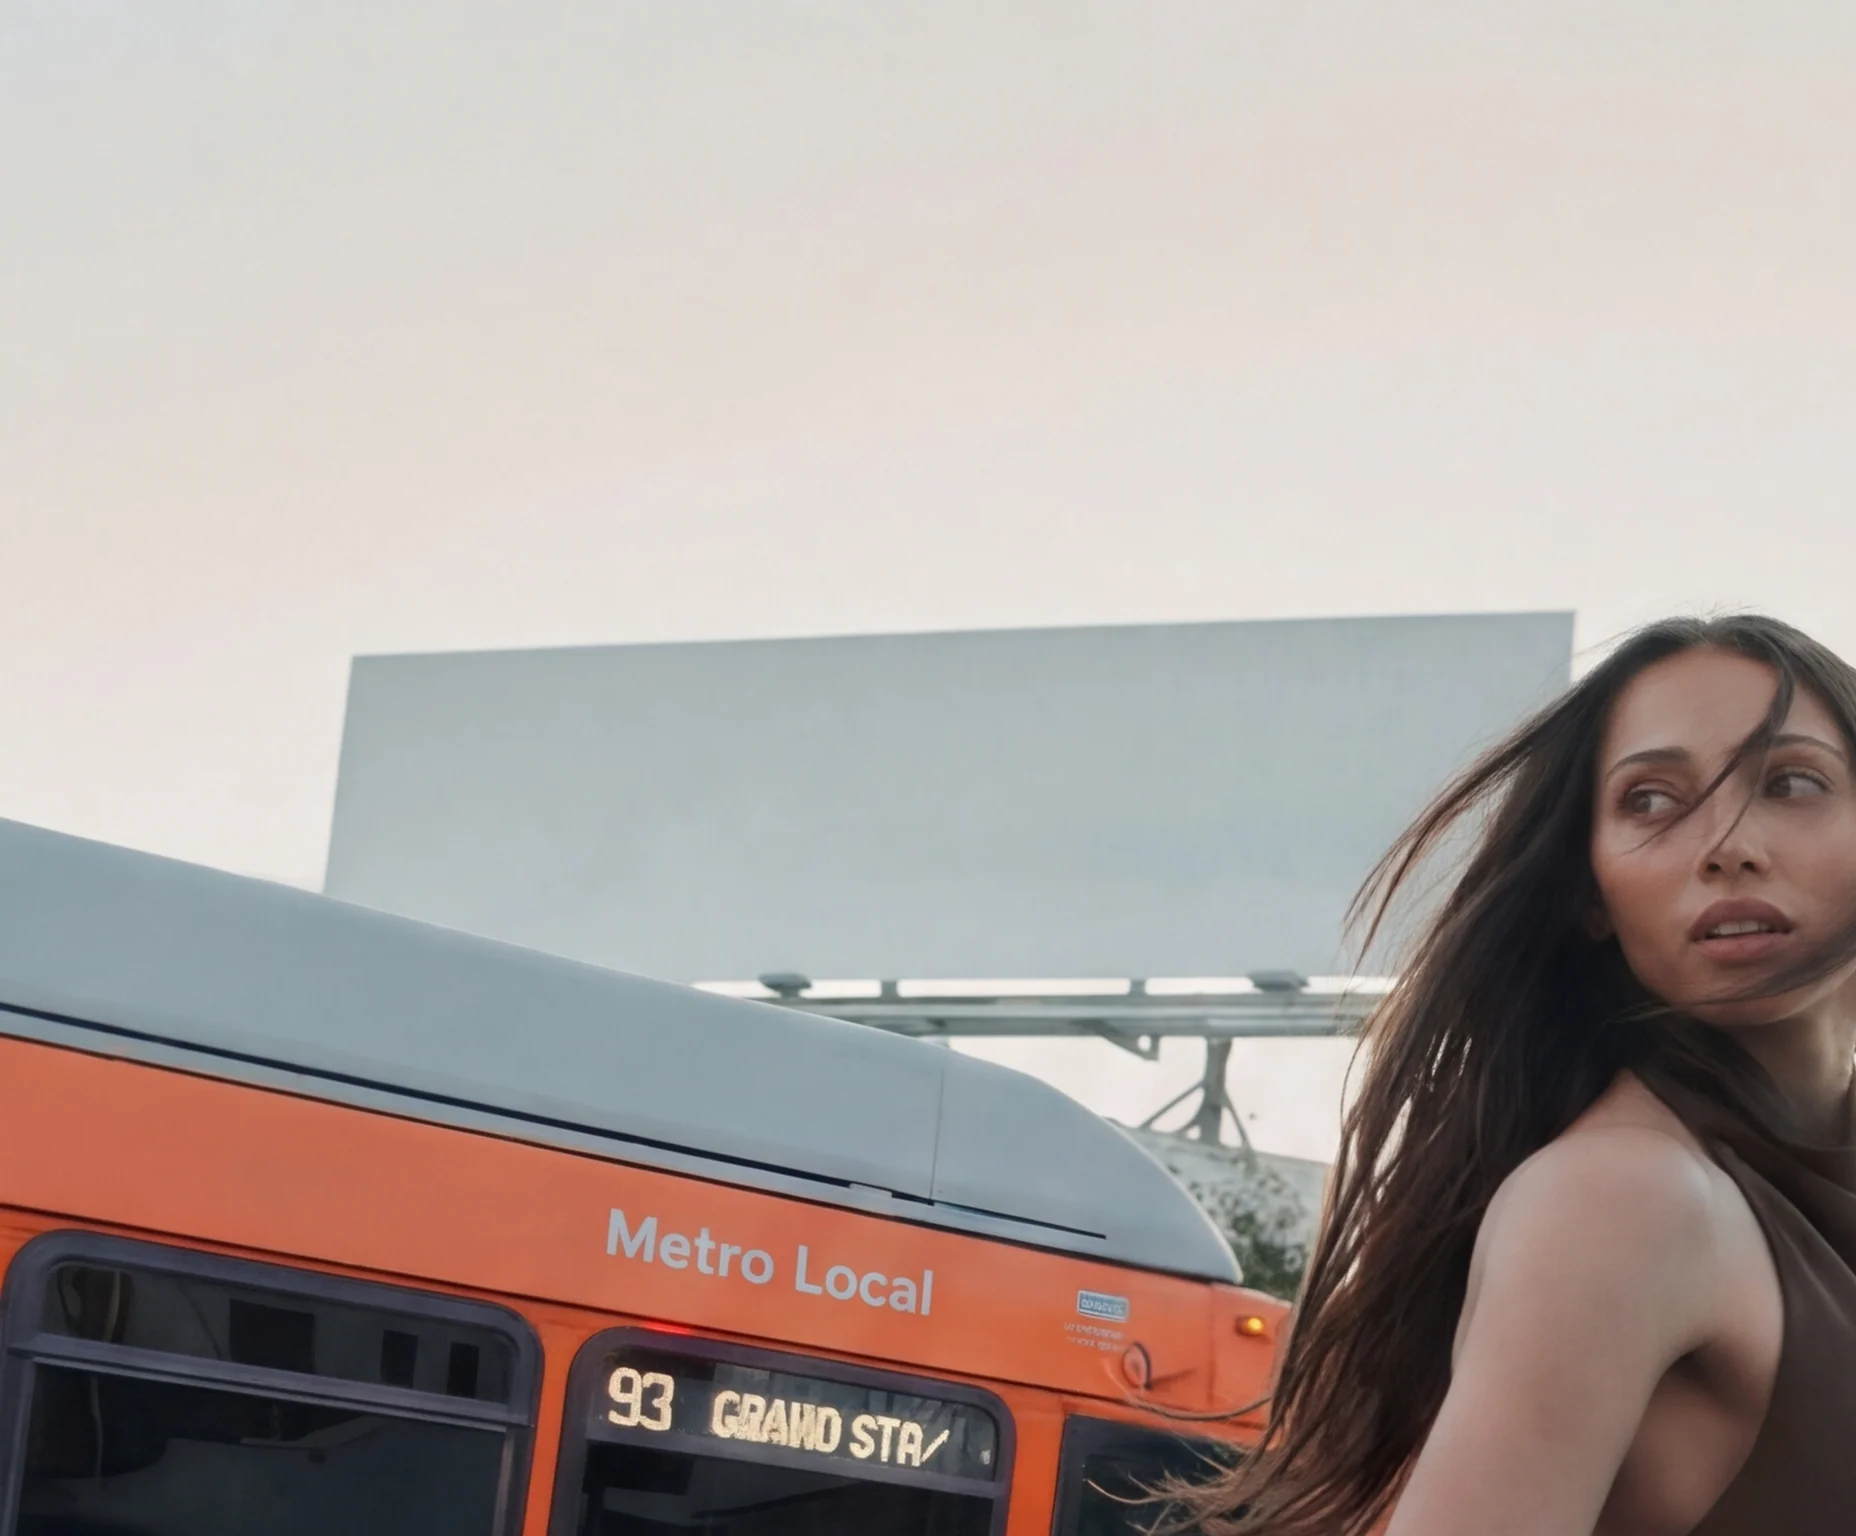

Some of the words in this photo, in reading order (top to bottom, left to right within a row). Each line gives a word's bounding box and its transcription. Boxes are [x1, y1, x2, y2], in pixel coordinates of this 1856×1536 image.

[606, 1207, 774, 1285] Metro
[795, 1244, 934, 1316] Local
[607, 1366, 675, 1431] 93
